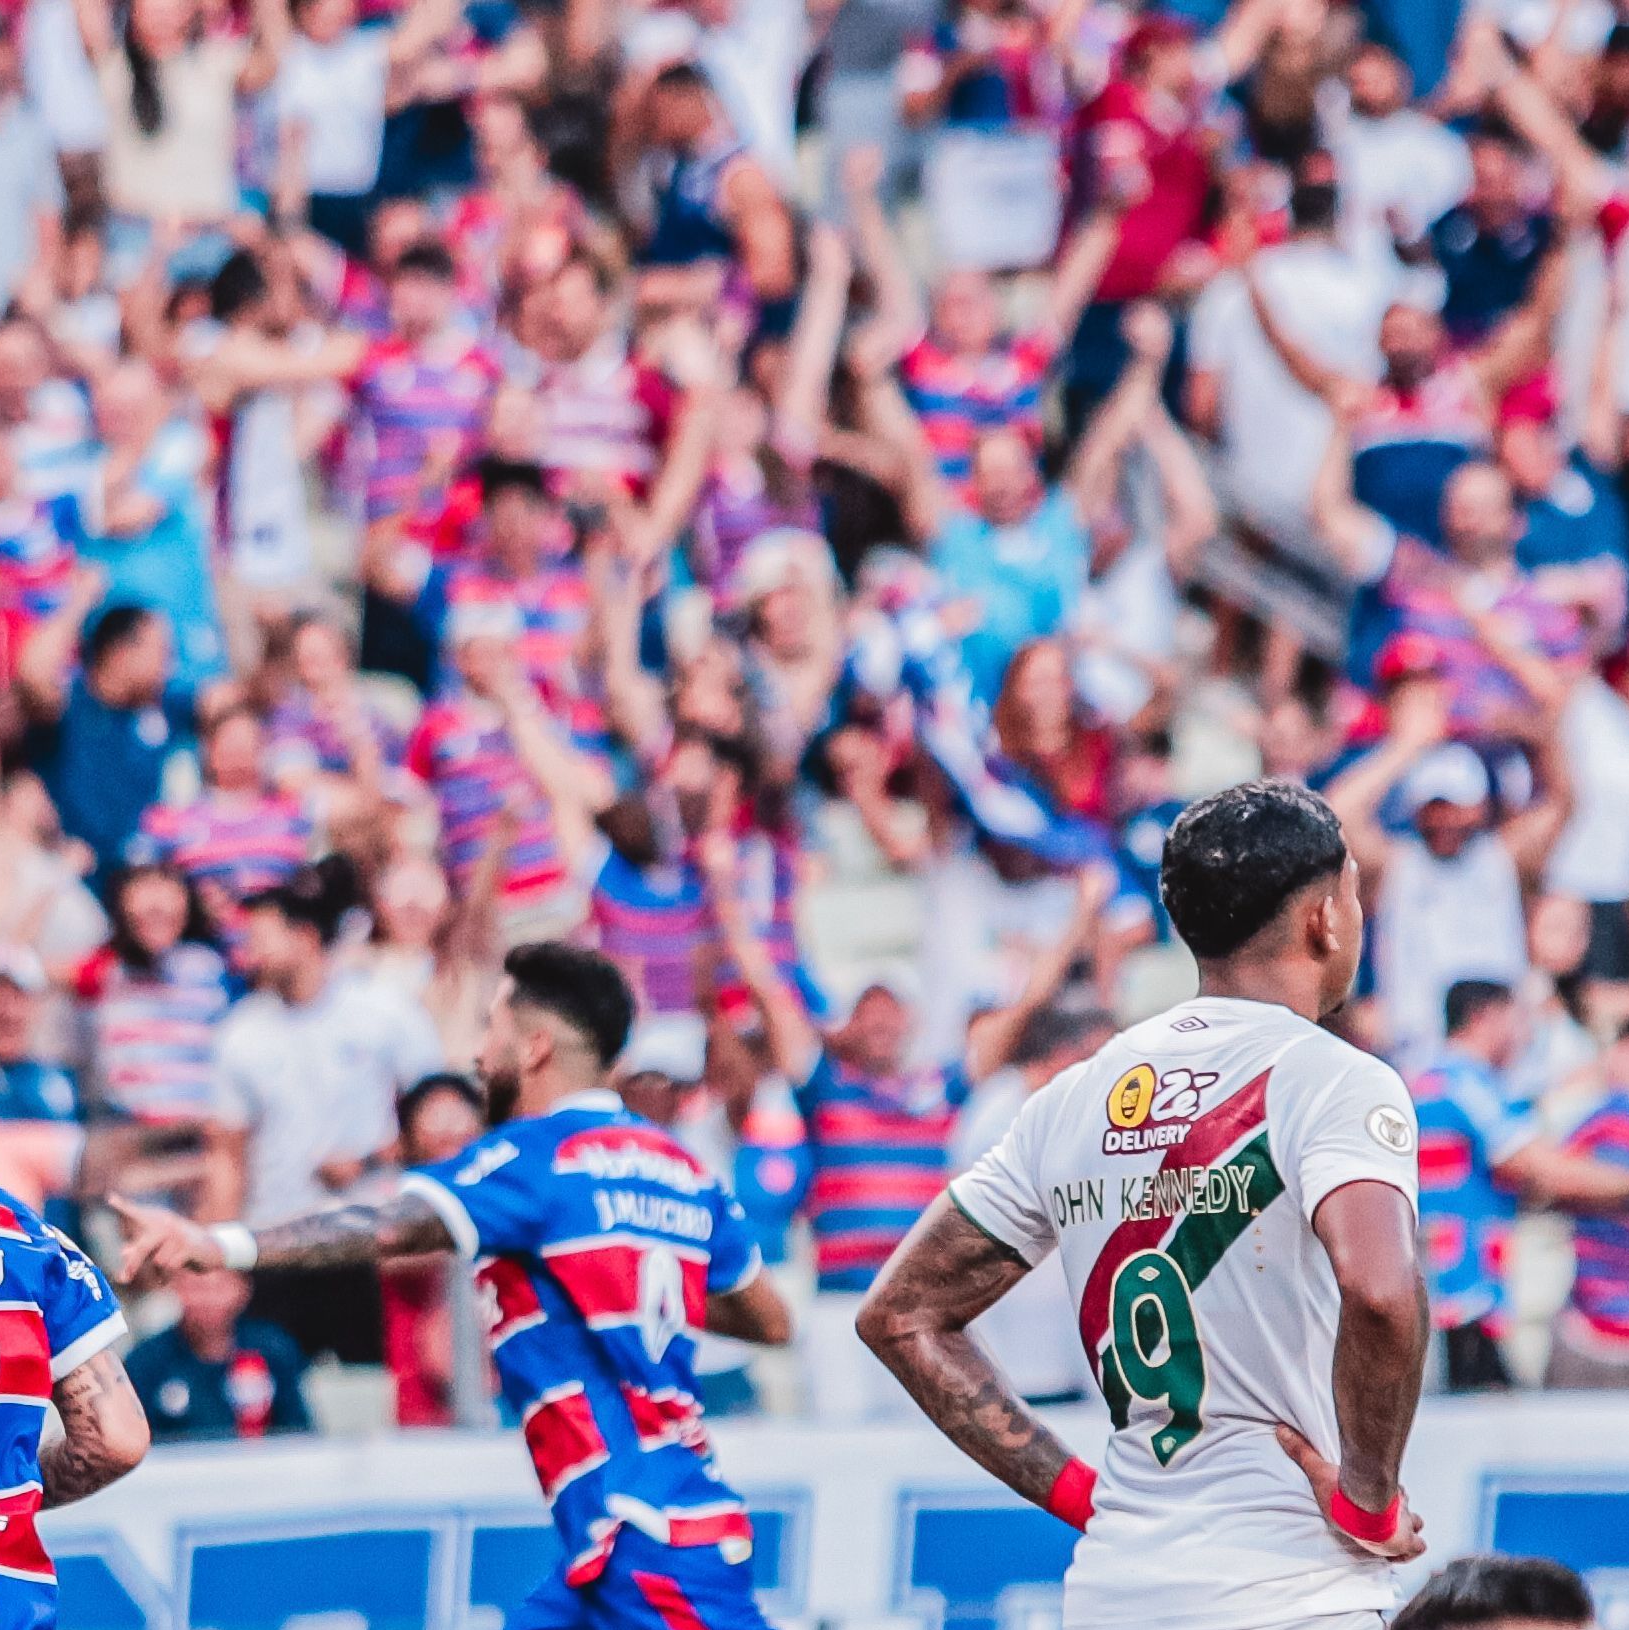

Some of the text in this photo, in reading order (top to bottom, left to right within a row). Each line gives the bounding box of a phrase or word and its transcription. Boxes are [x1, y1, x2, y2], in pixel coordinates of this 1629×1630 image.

[1105, 1124, 1192, 1154] DELIVERY
[1050, 1165, 1256, 1229] OHN KENNEDY
[1109, 1248, 1208, 1469] 9
